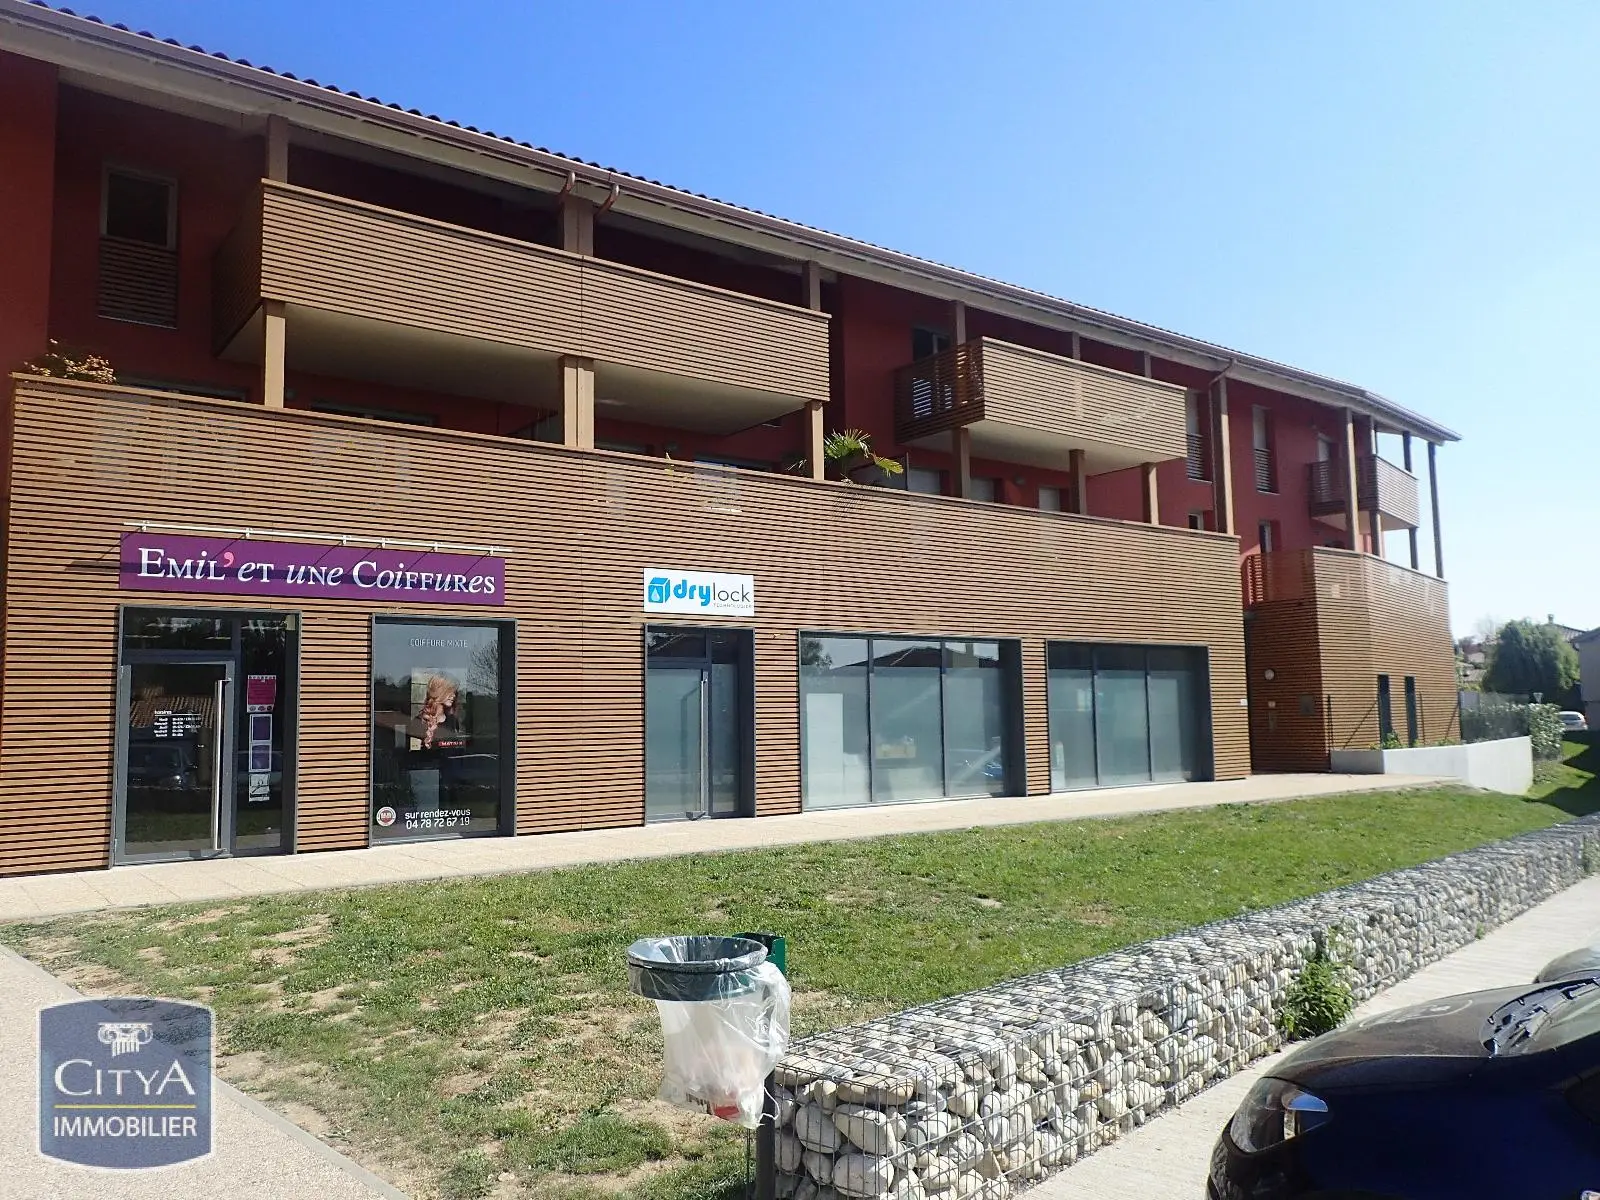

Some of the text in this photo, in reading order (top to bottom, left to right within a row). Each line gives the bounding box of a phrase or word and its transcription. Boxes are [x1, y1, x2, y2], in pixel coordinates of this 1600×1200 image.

[673, 579, 751, 607] drylock
[410, 638, 468, 648] COIFFURE MIXTE
[405, 808, 471, 820] sur rendez-vous
[406, 816, 470, 830] 04 78 72 67 19
